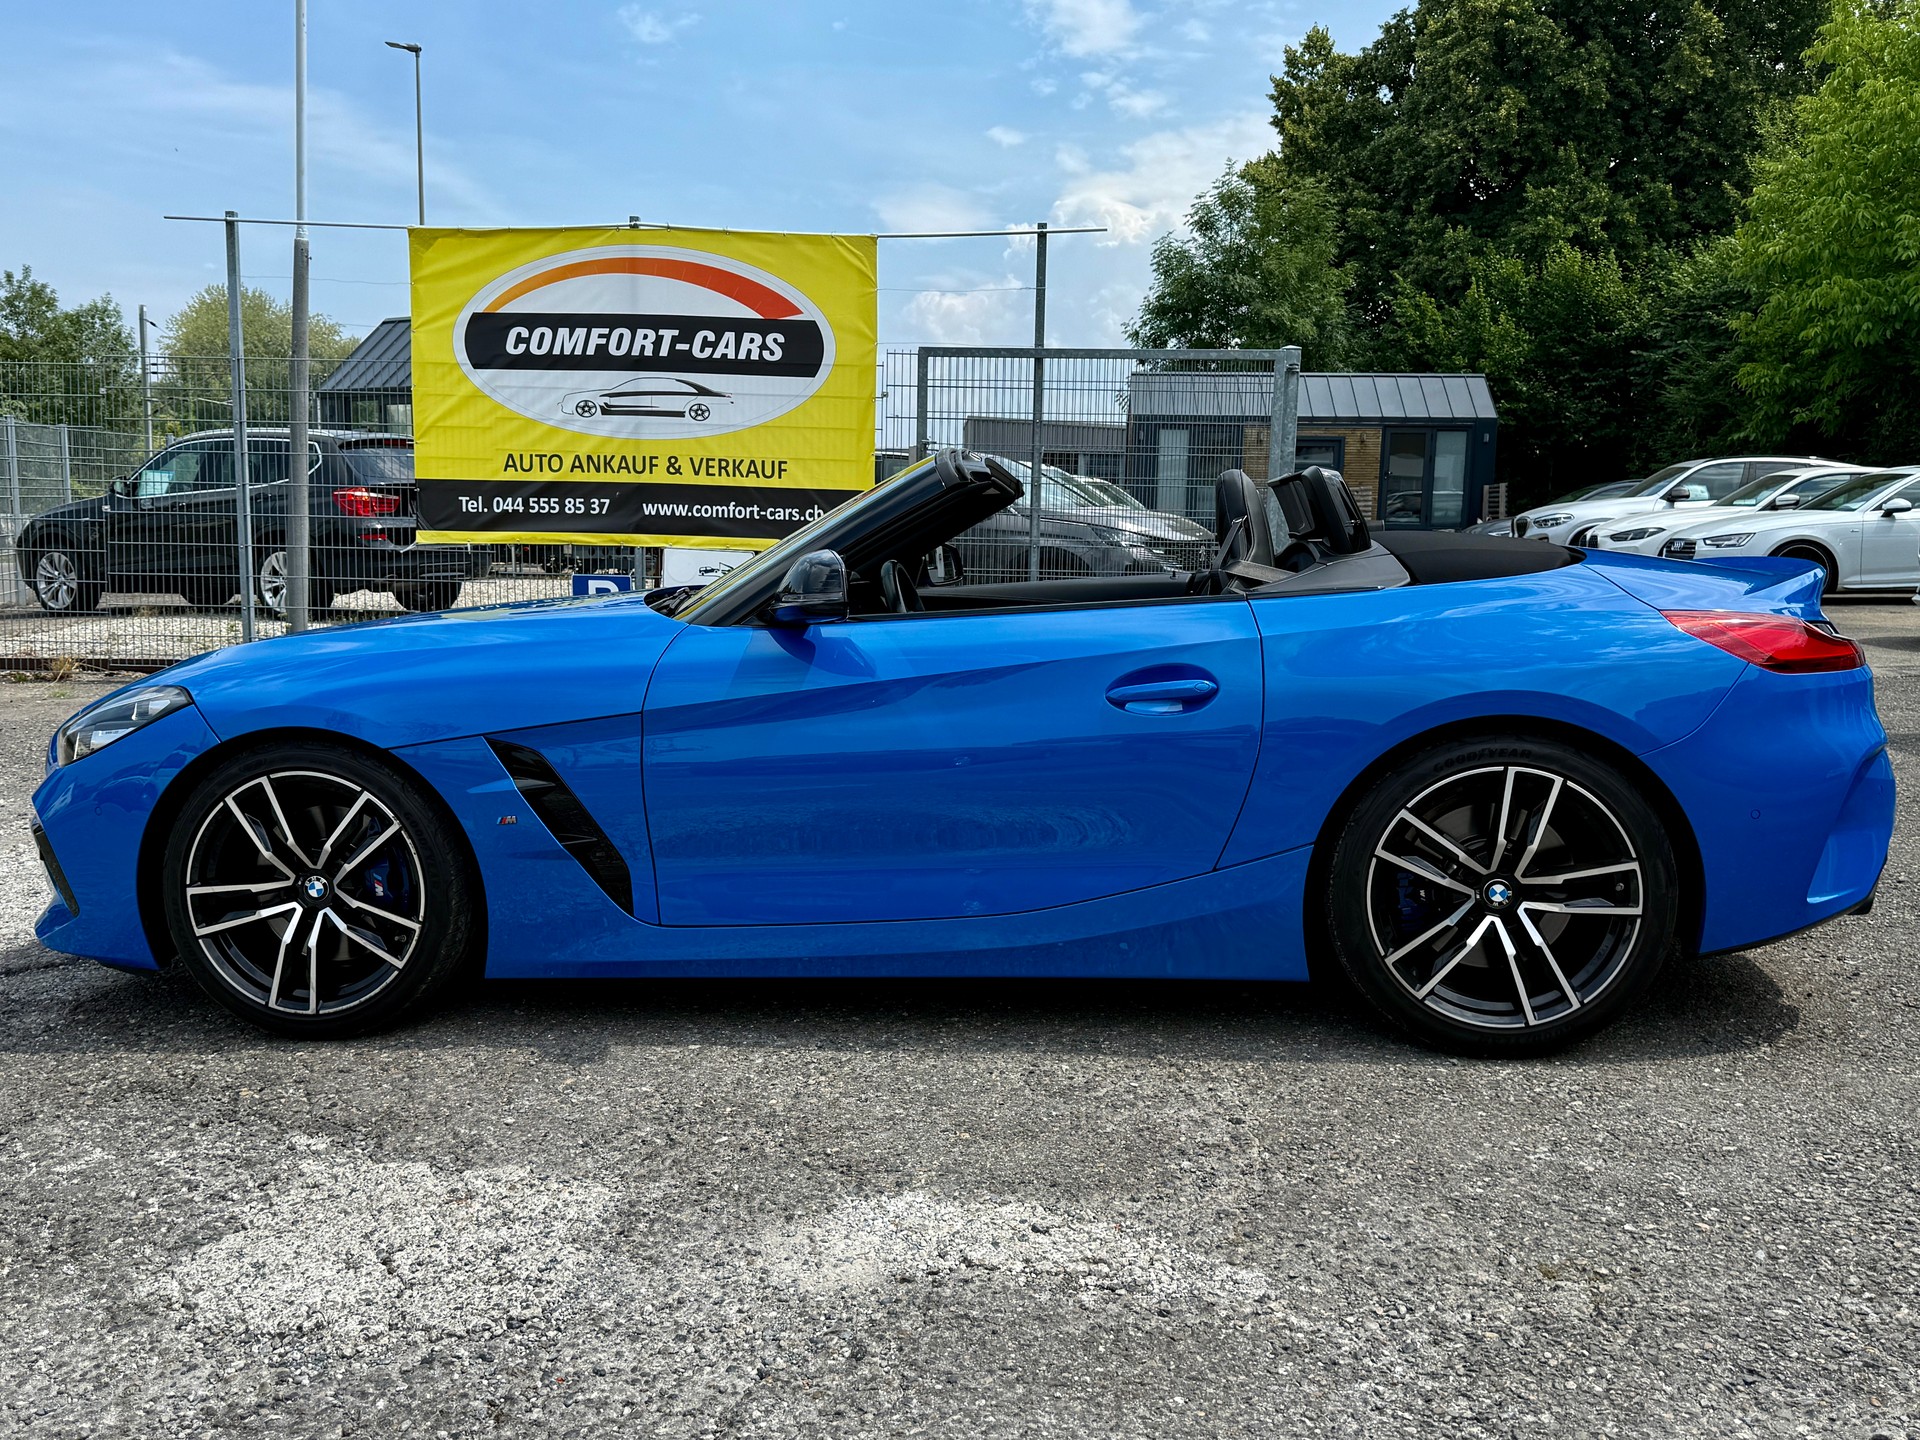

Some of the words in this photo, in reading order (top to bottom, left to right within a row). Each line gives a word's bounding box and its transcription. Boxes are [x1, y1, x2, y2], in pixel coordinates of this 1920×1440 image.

[505, 326, 786, 361] COMFORT-CARS
[503, 453, 564, 473] AUTO
[570, 454, 660, 475] ANKAUF
[666, 455, 684, 476] &
[689, 457, 788, 480] VERKAUF
[458, 496, 488, 513] Tel.
[493, 497, 525, 513] 044
[529, 498, 560, 514] 555
[564, 498, 585, 514] 85
[590, 498, 611, 514] 37
[642, 502, 825, 521] www.comfort-cars.ch
[1433, 748, 1532, 773] GOODYEAR
